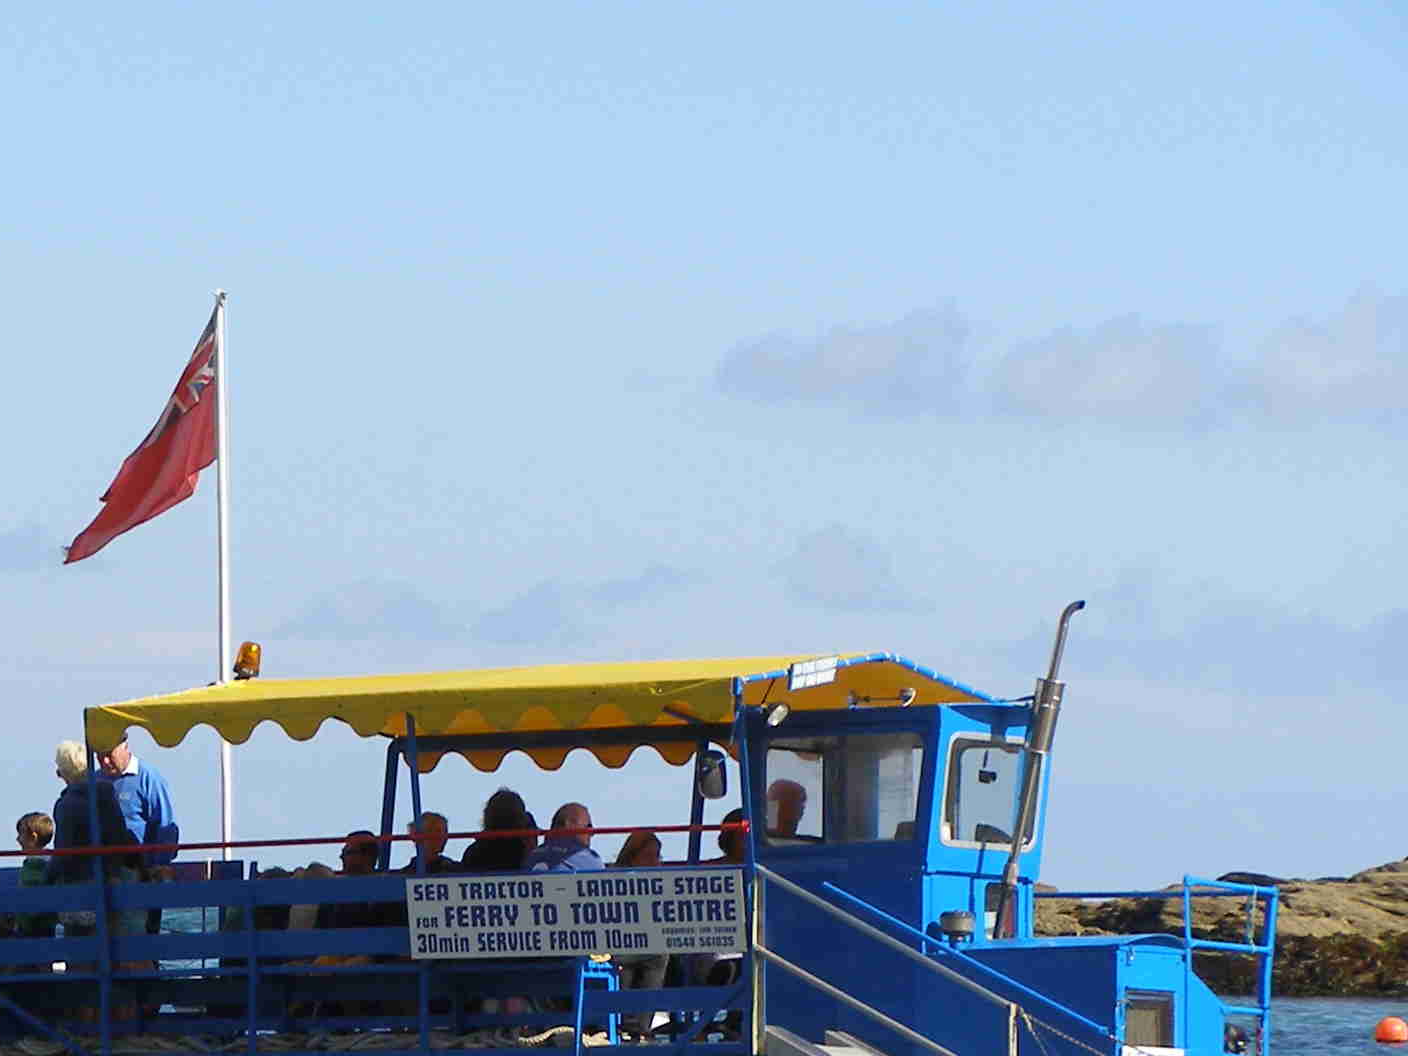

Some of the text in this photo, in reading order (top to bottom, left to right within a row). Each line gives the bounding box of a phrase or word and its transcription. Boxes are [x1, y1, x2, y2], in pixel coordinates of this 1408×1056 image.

[413, 883, 449, 901] SEA
[458, 880, 544, 900] TRACTOR
[576, 878, 663, 897] LANDING
[674, 876, 735, 895] STAGE
[416, 900, 736, 928] FOR FERRY TO TOWN CENTRE
[417, 929, 648, 953] 30min SERVICE FROM 10am
